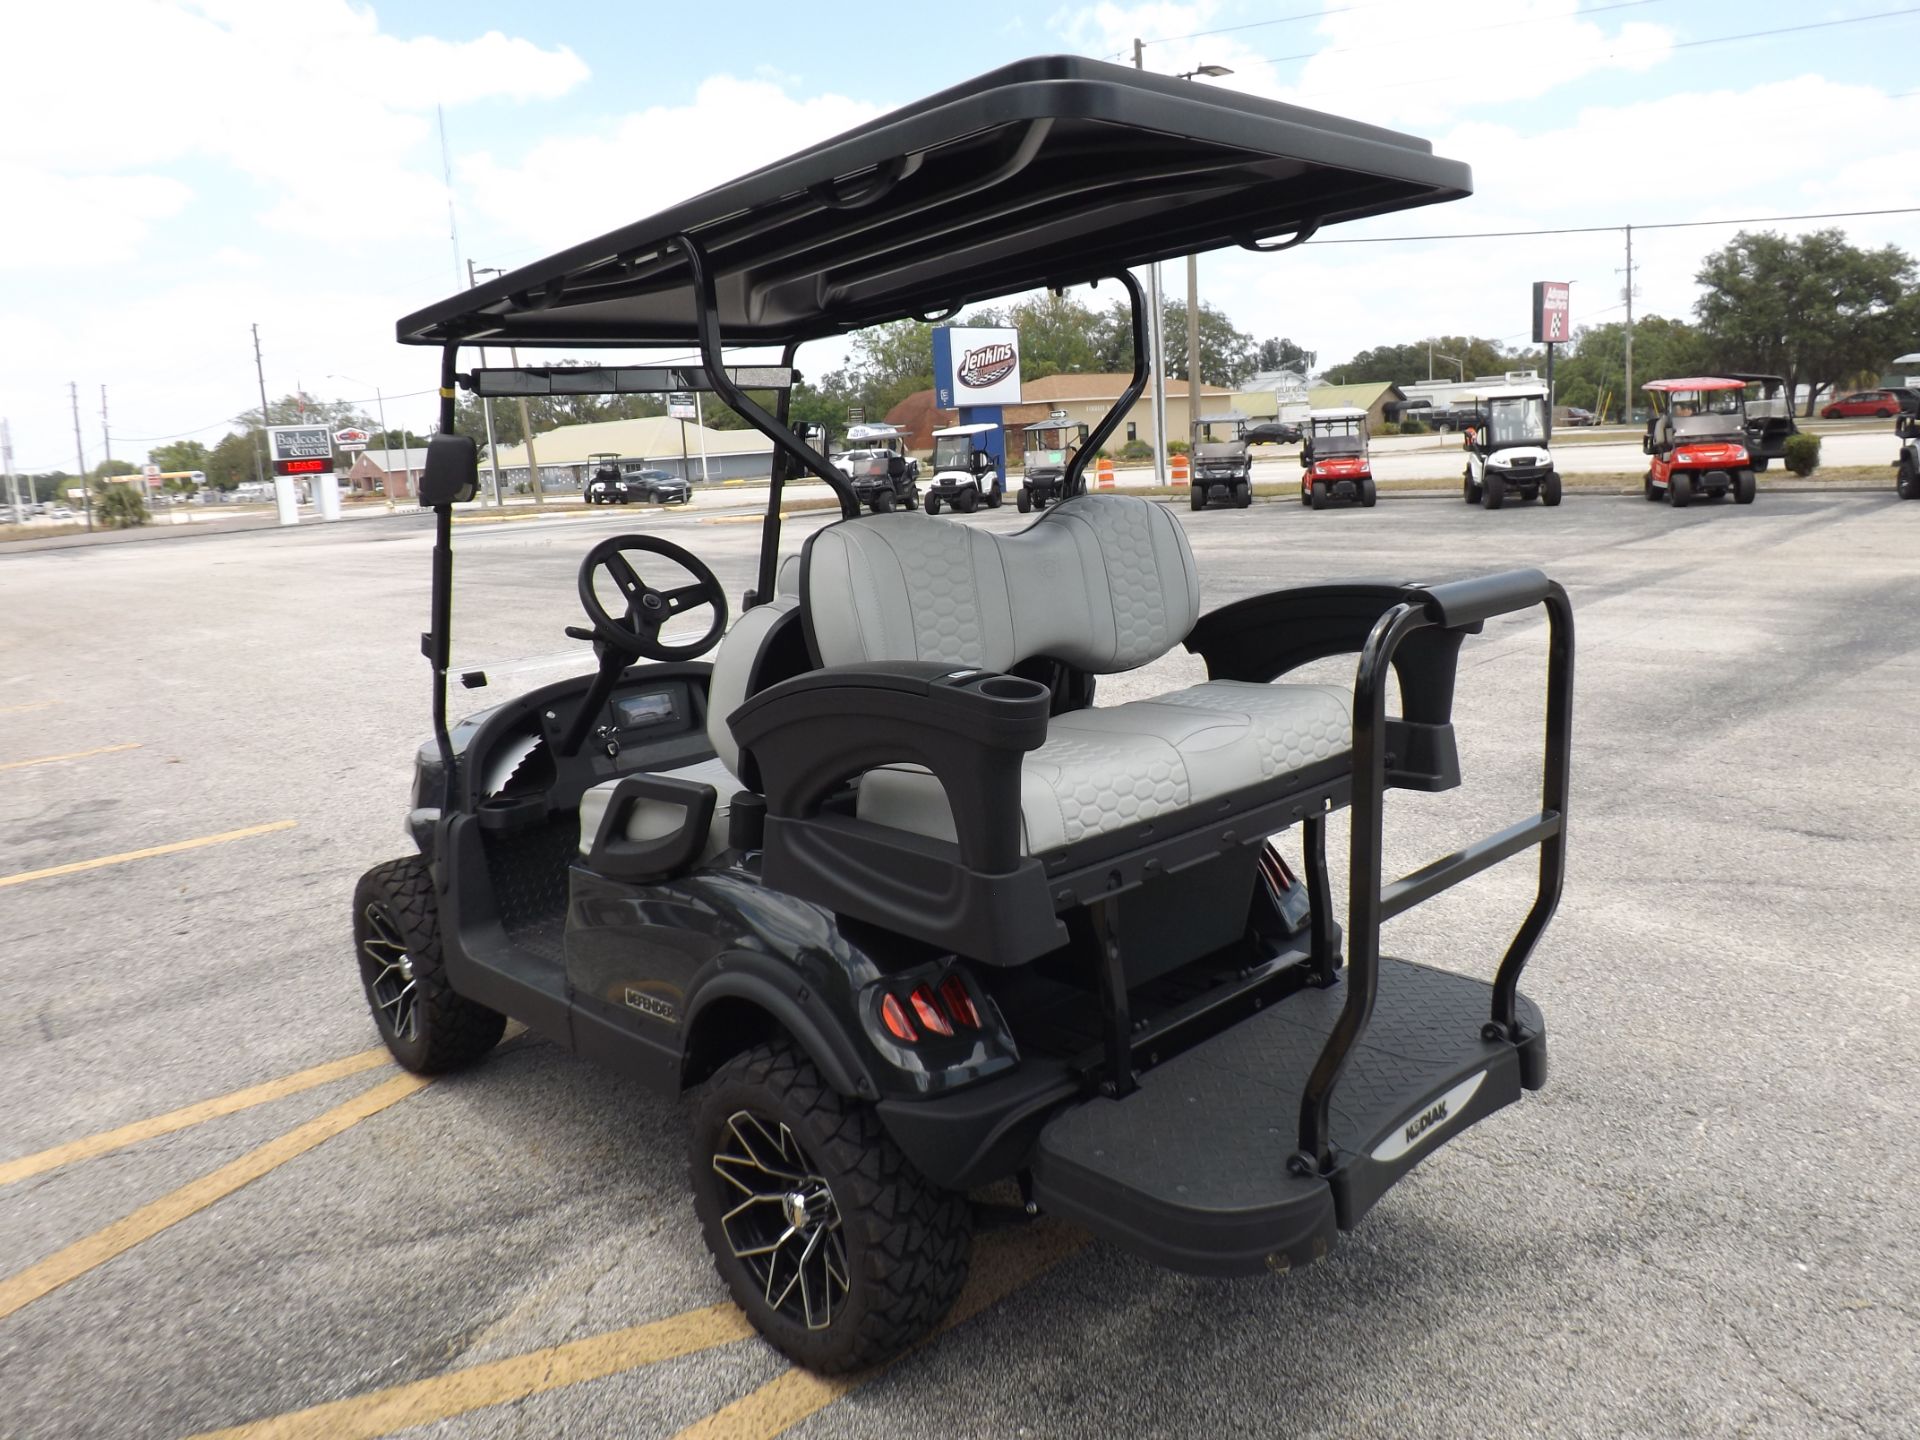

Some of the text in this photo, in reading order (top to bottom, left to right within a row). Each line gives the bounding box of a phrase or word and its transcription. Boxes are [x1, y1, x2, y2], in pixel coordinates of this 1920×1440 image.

[960, 343, 1012, 376] Jenkins
[276, 431, 327, 446] Badcock
[290, 446, 329, 456] &more
